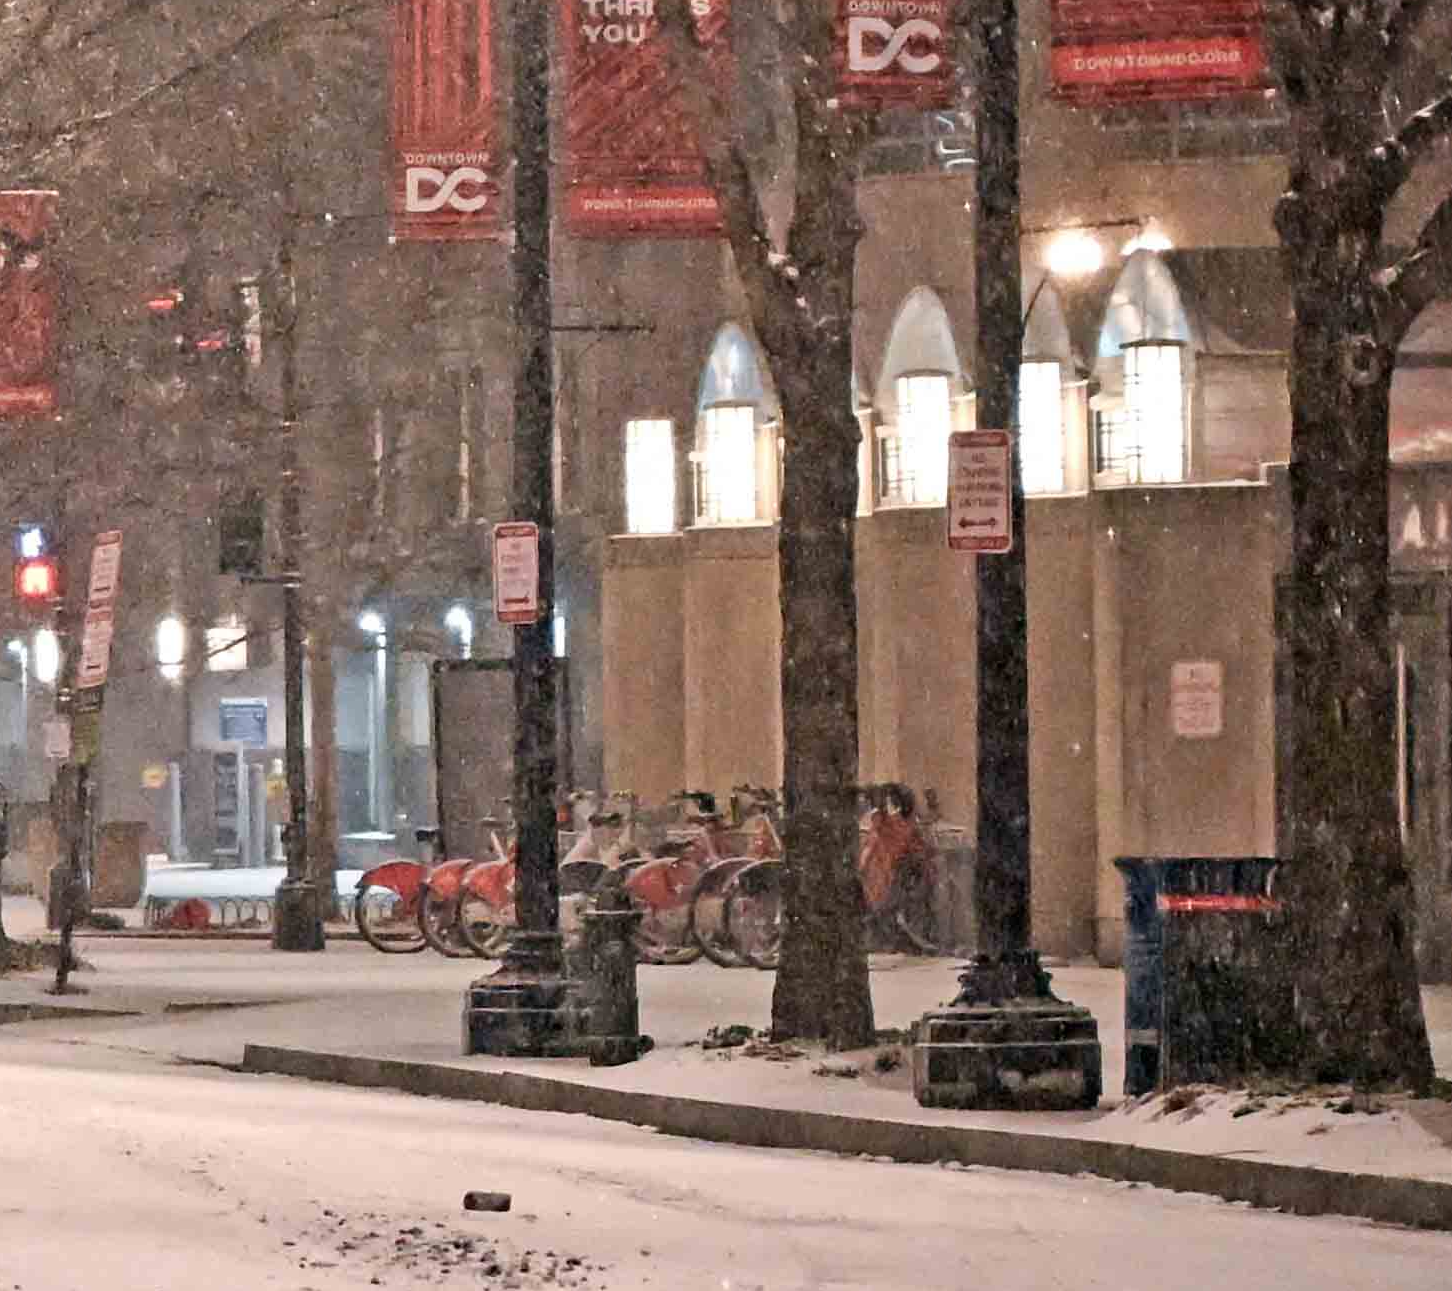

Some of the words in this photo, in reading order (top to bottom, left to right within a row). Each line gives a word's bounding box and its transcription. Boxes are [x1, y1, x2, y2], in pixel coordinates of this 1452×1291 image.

[848, 0, 941, 15] DOWNTOWN
[582, 24, 646, 44] YOU
[848, 16, 941, 73] DC
[1073, 50, 1243, 71] DOWNTOWNDC.ORG
[404, 152, 490, 166] DOWNTOWN
[405, 167, 488, 213] DC
